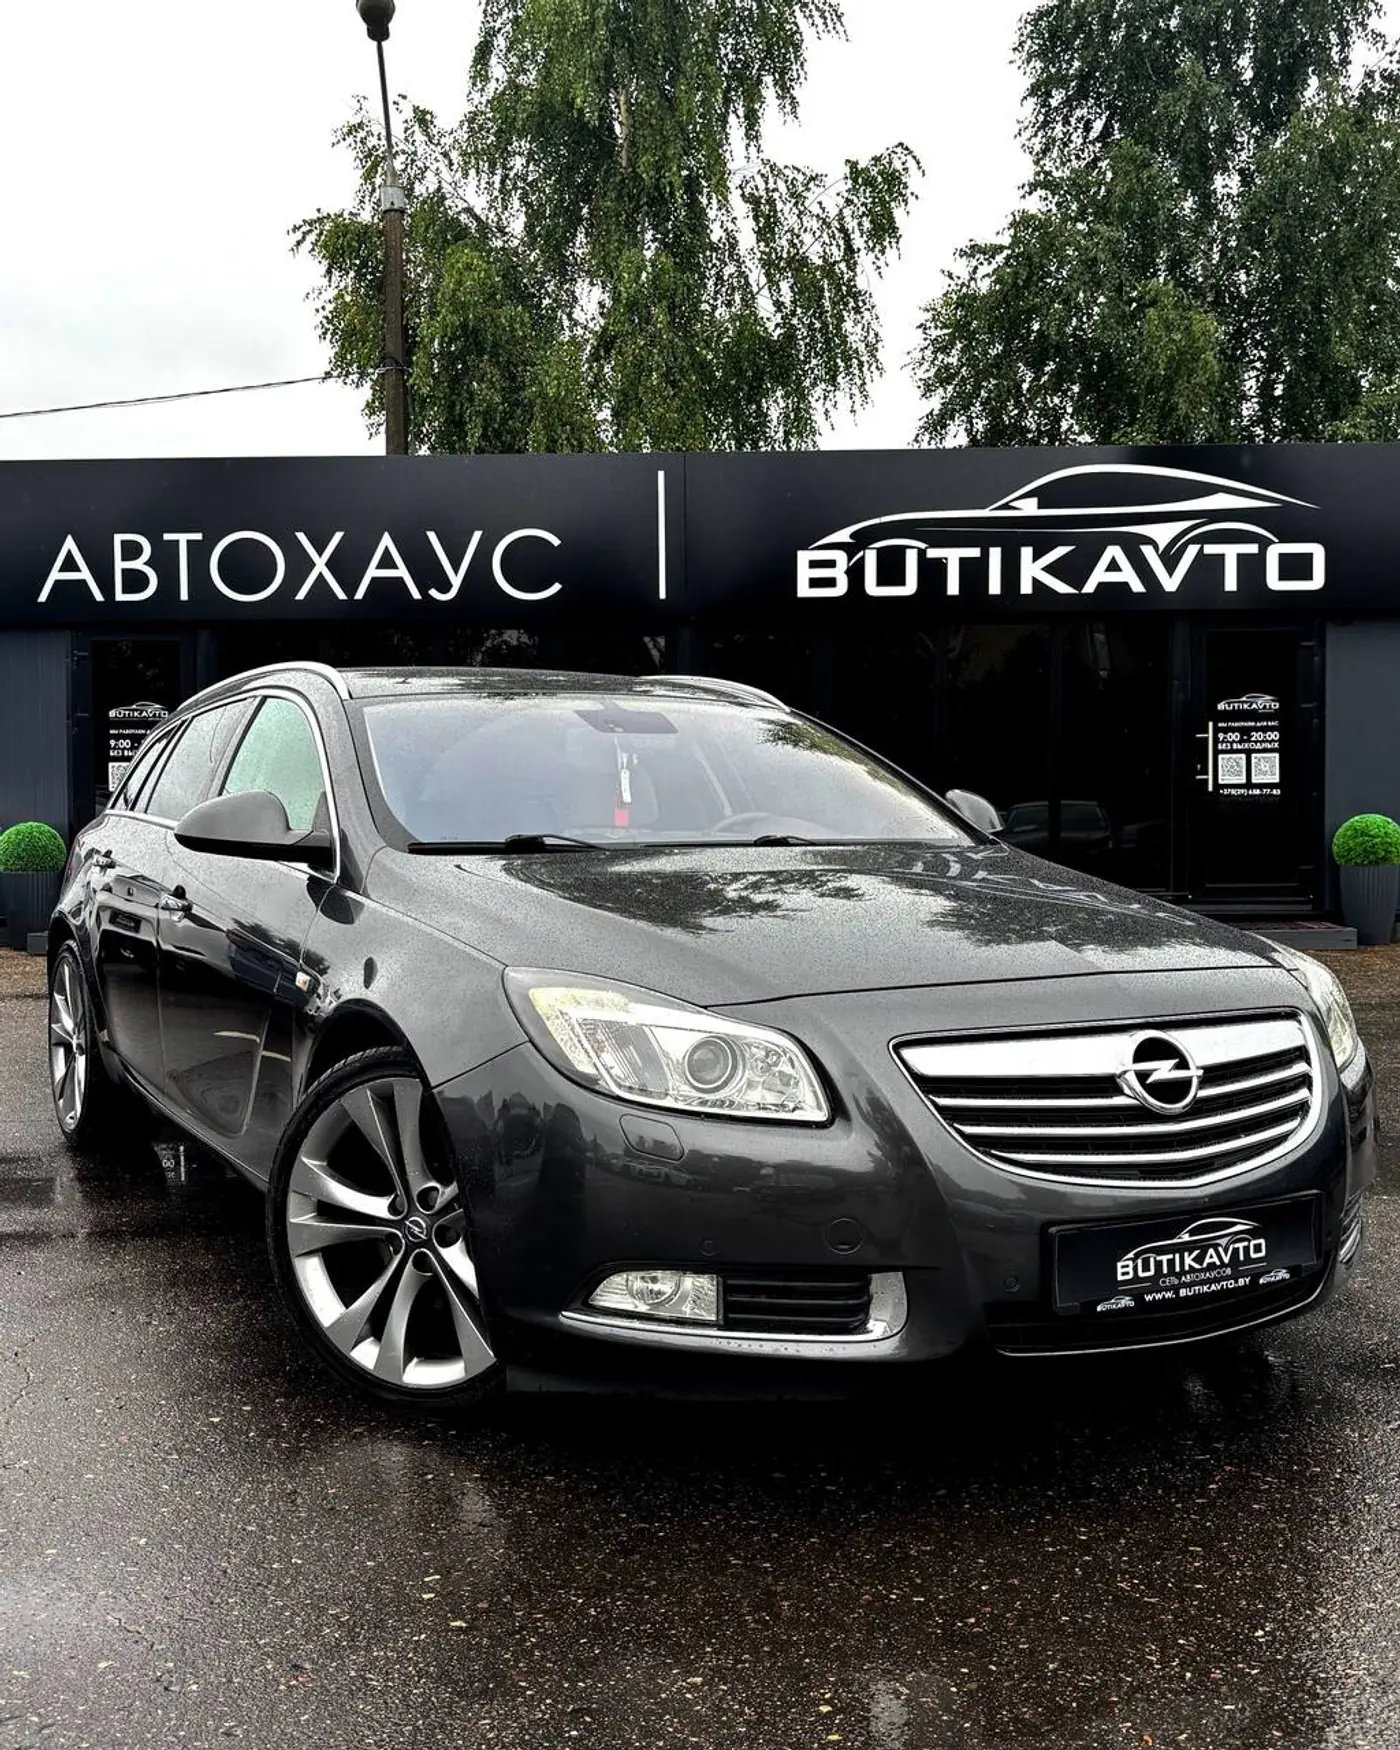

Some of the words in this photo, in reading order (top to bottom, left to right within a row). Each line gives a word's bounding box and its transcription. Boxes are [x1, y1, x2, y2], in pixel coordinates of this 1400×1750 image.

[36, 527, 563, 603] АВТОХАУС
[796, 541, 1326, 599] BUTIKAVTO
[1217, 702, 1280, 710] BUTIKAVTO
[109, 739, 131, 748] 9:00
[1218, 732, 1240, 742] 9:00
[1250, 731, 1280, 741] 20:00
[1116, 1239, 1266, 1281] BUTIKAVTO
[1159, 1273, 1179, 1287] СЕТЬ
[1180, 1267, 1232, 1285] АВТОХАУСОВ
[1144, 1289, 1176, 1302] WWW.
[1179, 1276, 1252, 1298] BUTIKAVTO.BY
[1096, 1300, 1135, 1312] BUTIKAVTO
